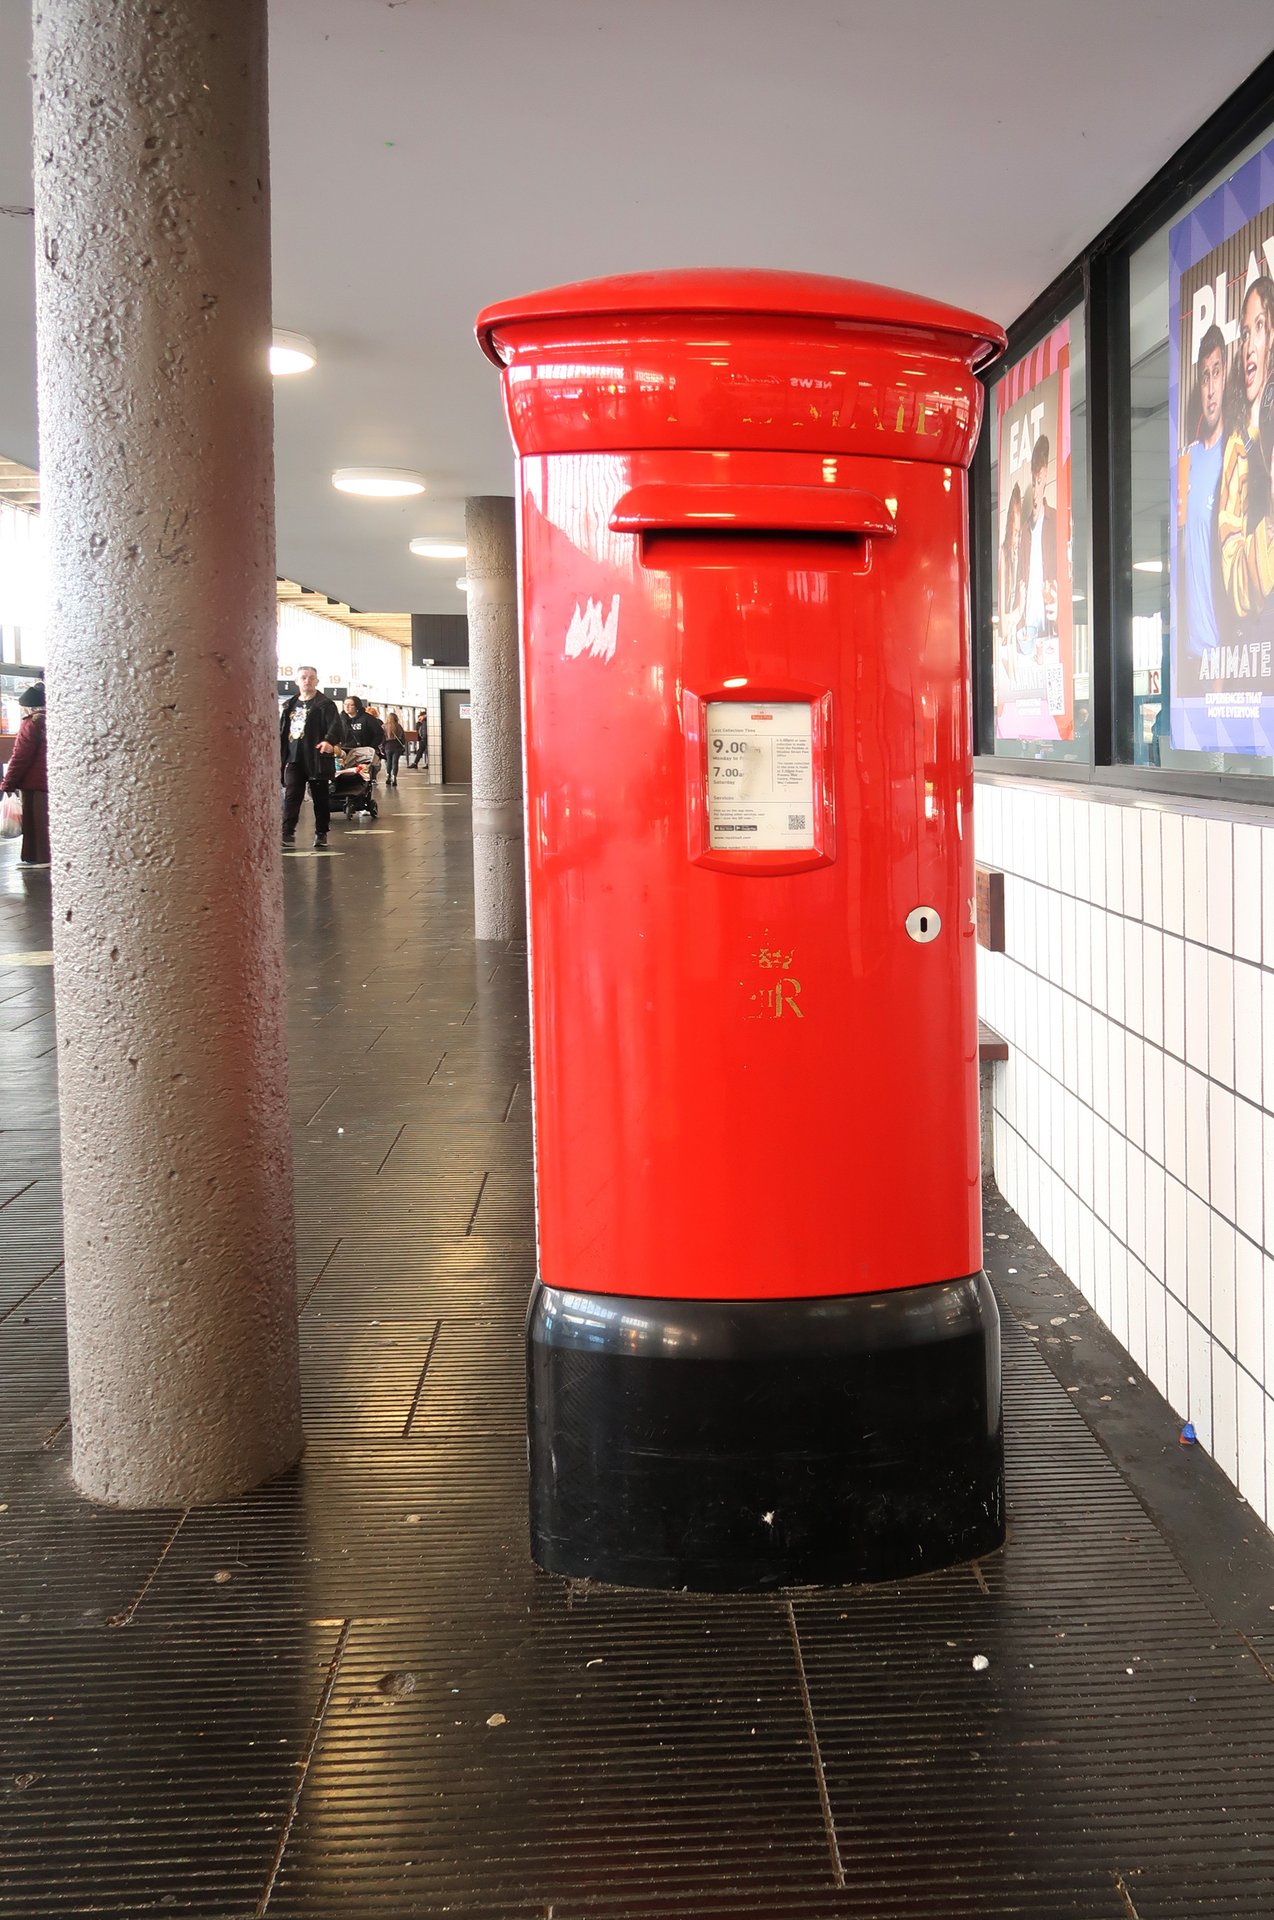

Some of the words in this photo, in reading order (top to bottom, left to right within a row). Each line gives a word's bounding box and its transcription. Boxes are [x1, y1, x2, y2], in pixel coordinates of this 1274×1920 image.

[1010, 402, 1045, 475] EAT
[1199, 641, 1271, 680] ANIMATE
[279, 666, 293, 677] 18
[329, 675, 341, 684] 19
[1205, 692, 1245, 704] EXPERIENCES
[1246, 691, 1263, 704] THAT
[1207, 706, 1226, 718] MOVE
[1226, 706, 1260, 718] EVERYONE
